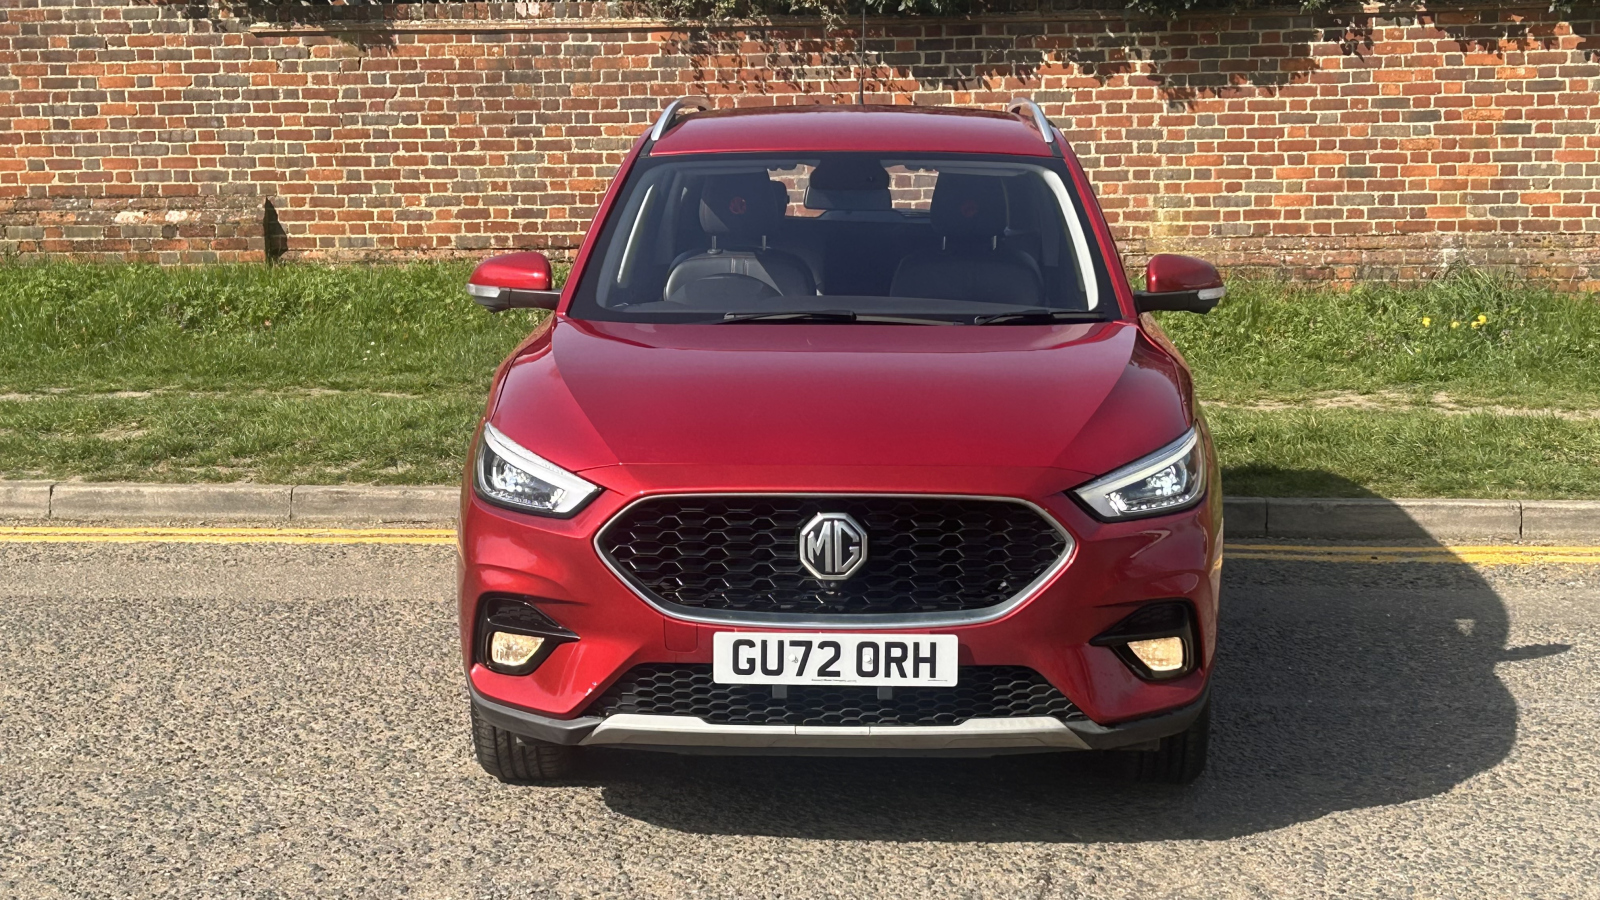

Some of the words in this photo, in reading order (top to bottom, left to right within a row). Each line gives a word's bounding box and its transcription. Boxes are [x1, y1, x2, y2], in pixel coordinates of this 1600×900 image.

[807, 520, 861, 573] MG
[732, 639, 841, 677] GU72
[856, 641, 937, 678] ORH
